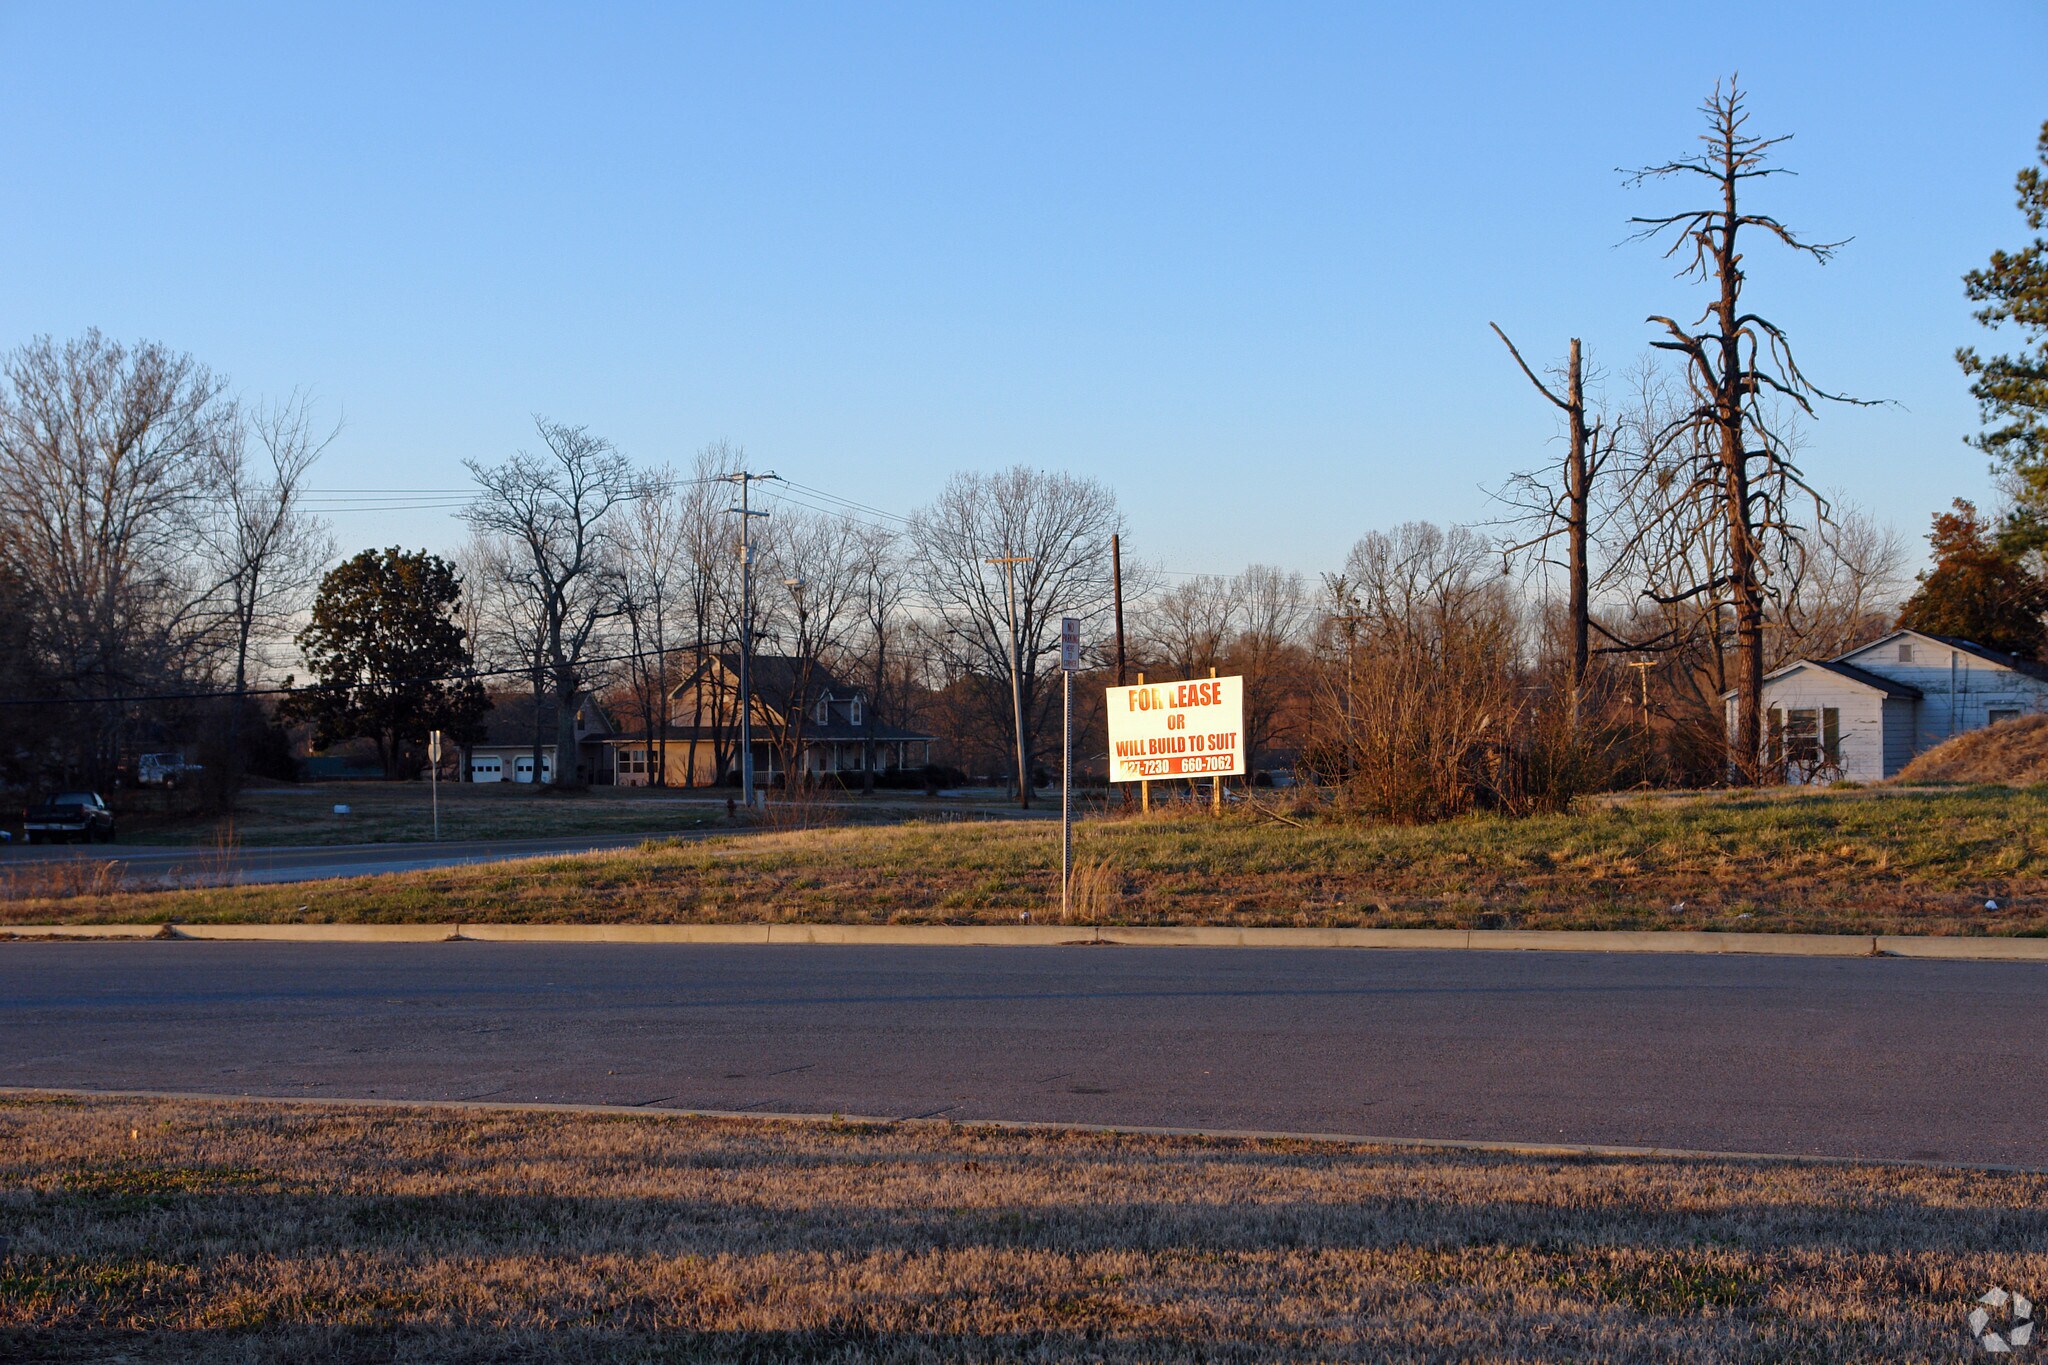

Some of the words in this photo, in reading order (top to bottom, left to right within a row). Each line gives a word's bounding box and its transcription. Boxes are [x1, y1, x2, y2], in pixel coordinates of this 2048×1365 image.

[1129, 688, 1164, 712] FOR
[1169, 682, 1221, 709] LEASE
[1167, 714, 1185, 730] OR
[1116, 739, 1146, 757] WILL
[1149, 737, 1185, 755] BUILD
[1188, 735, 1204, 751] TO
[1208, 732, 1236, 751] SUIT
[1181, 755, 1231, 773] 660-7062
